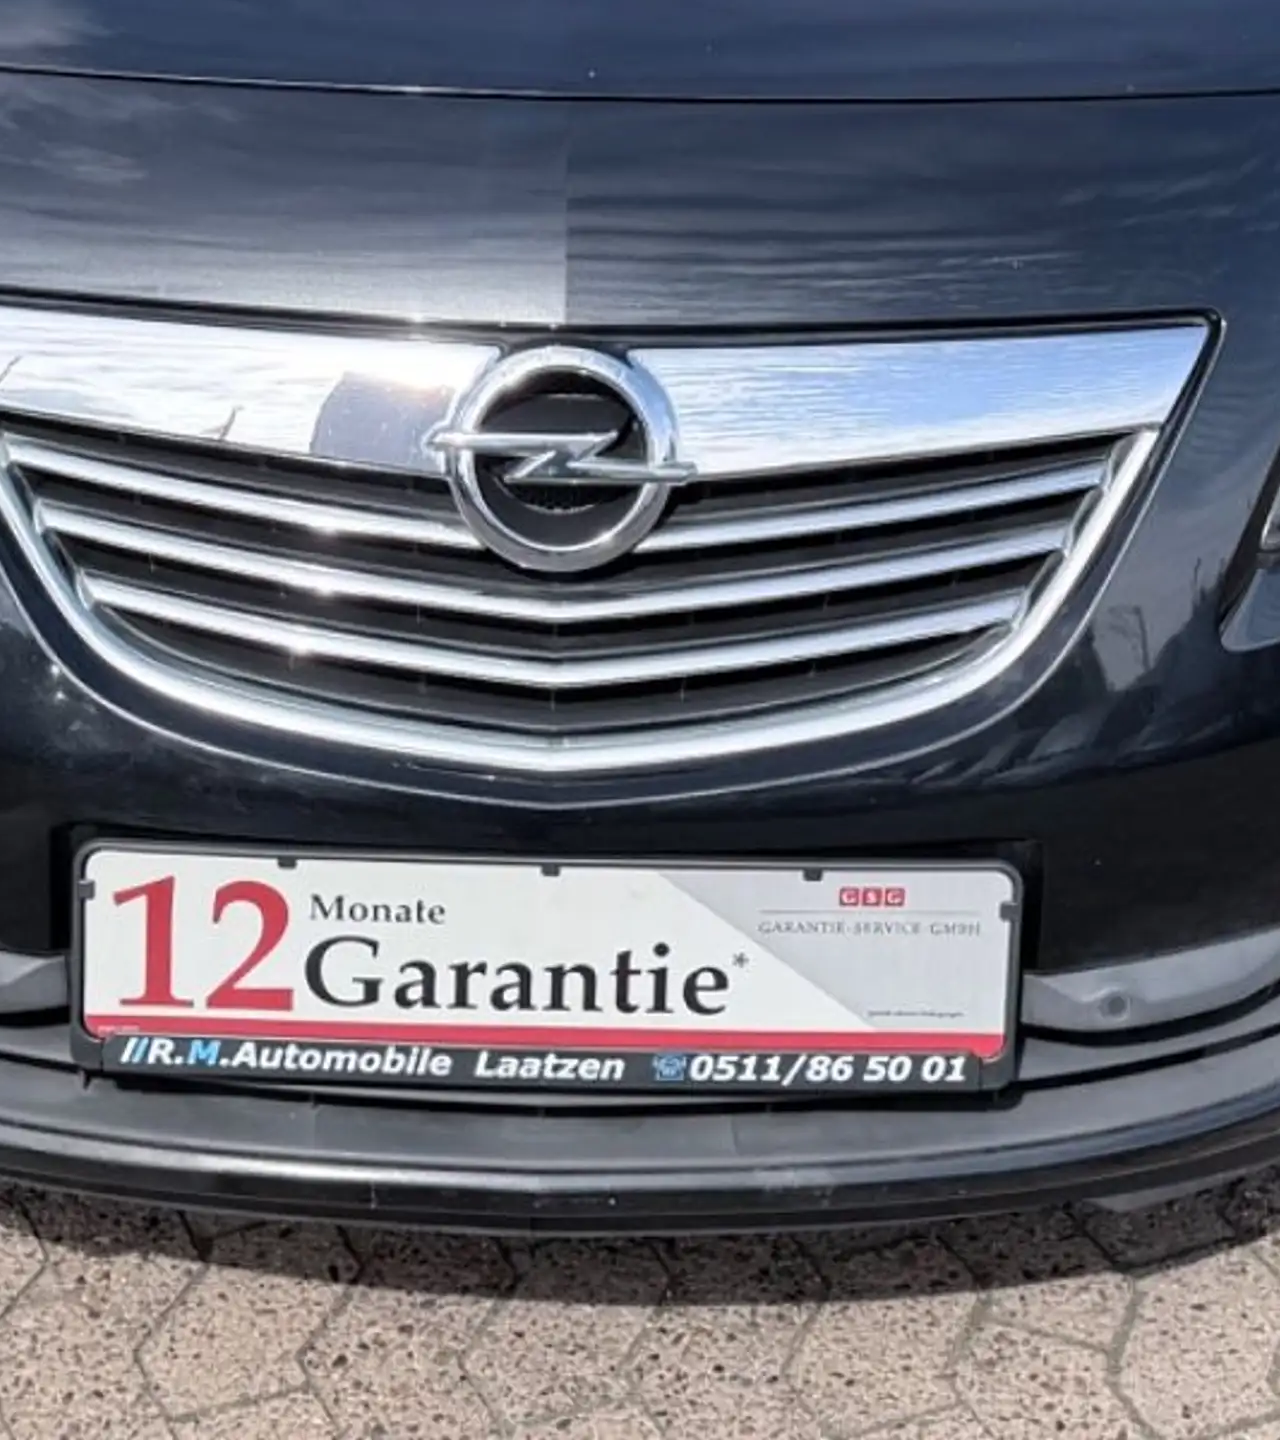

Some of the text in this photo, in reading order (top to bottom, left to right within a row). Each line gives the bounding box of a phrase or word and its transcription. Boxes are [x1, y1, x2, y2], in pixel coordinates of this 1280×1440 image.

[309, 893, 446, 925] Monate
[113, 874, 294, 1011] 12
[474, 1050, 626, 1080] Laatzen
[689, 1053, 854, 1087] 0511/86
[862, 1055, 913, 1083] 50
[920, 1055, 966, 1082] 01
